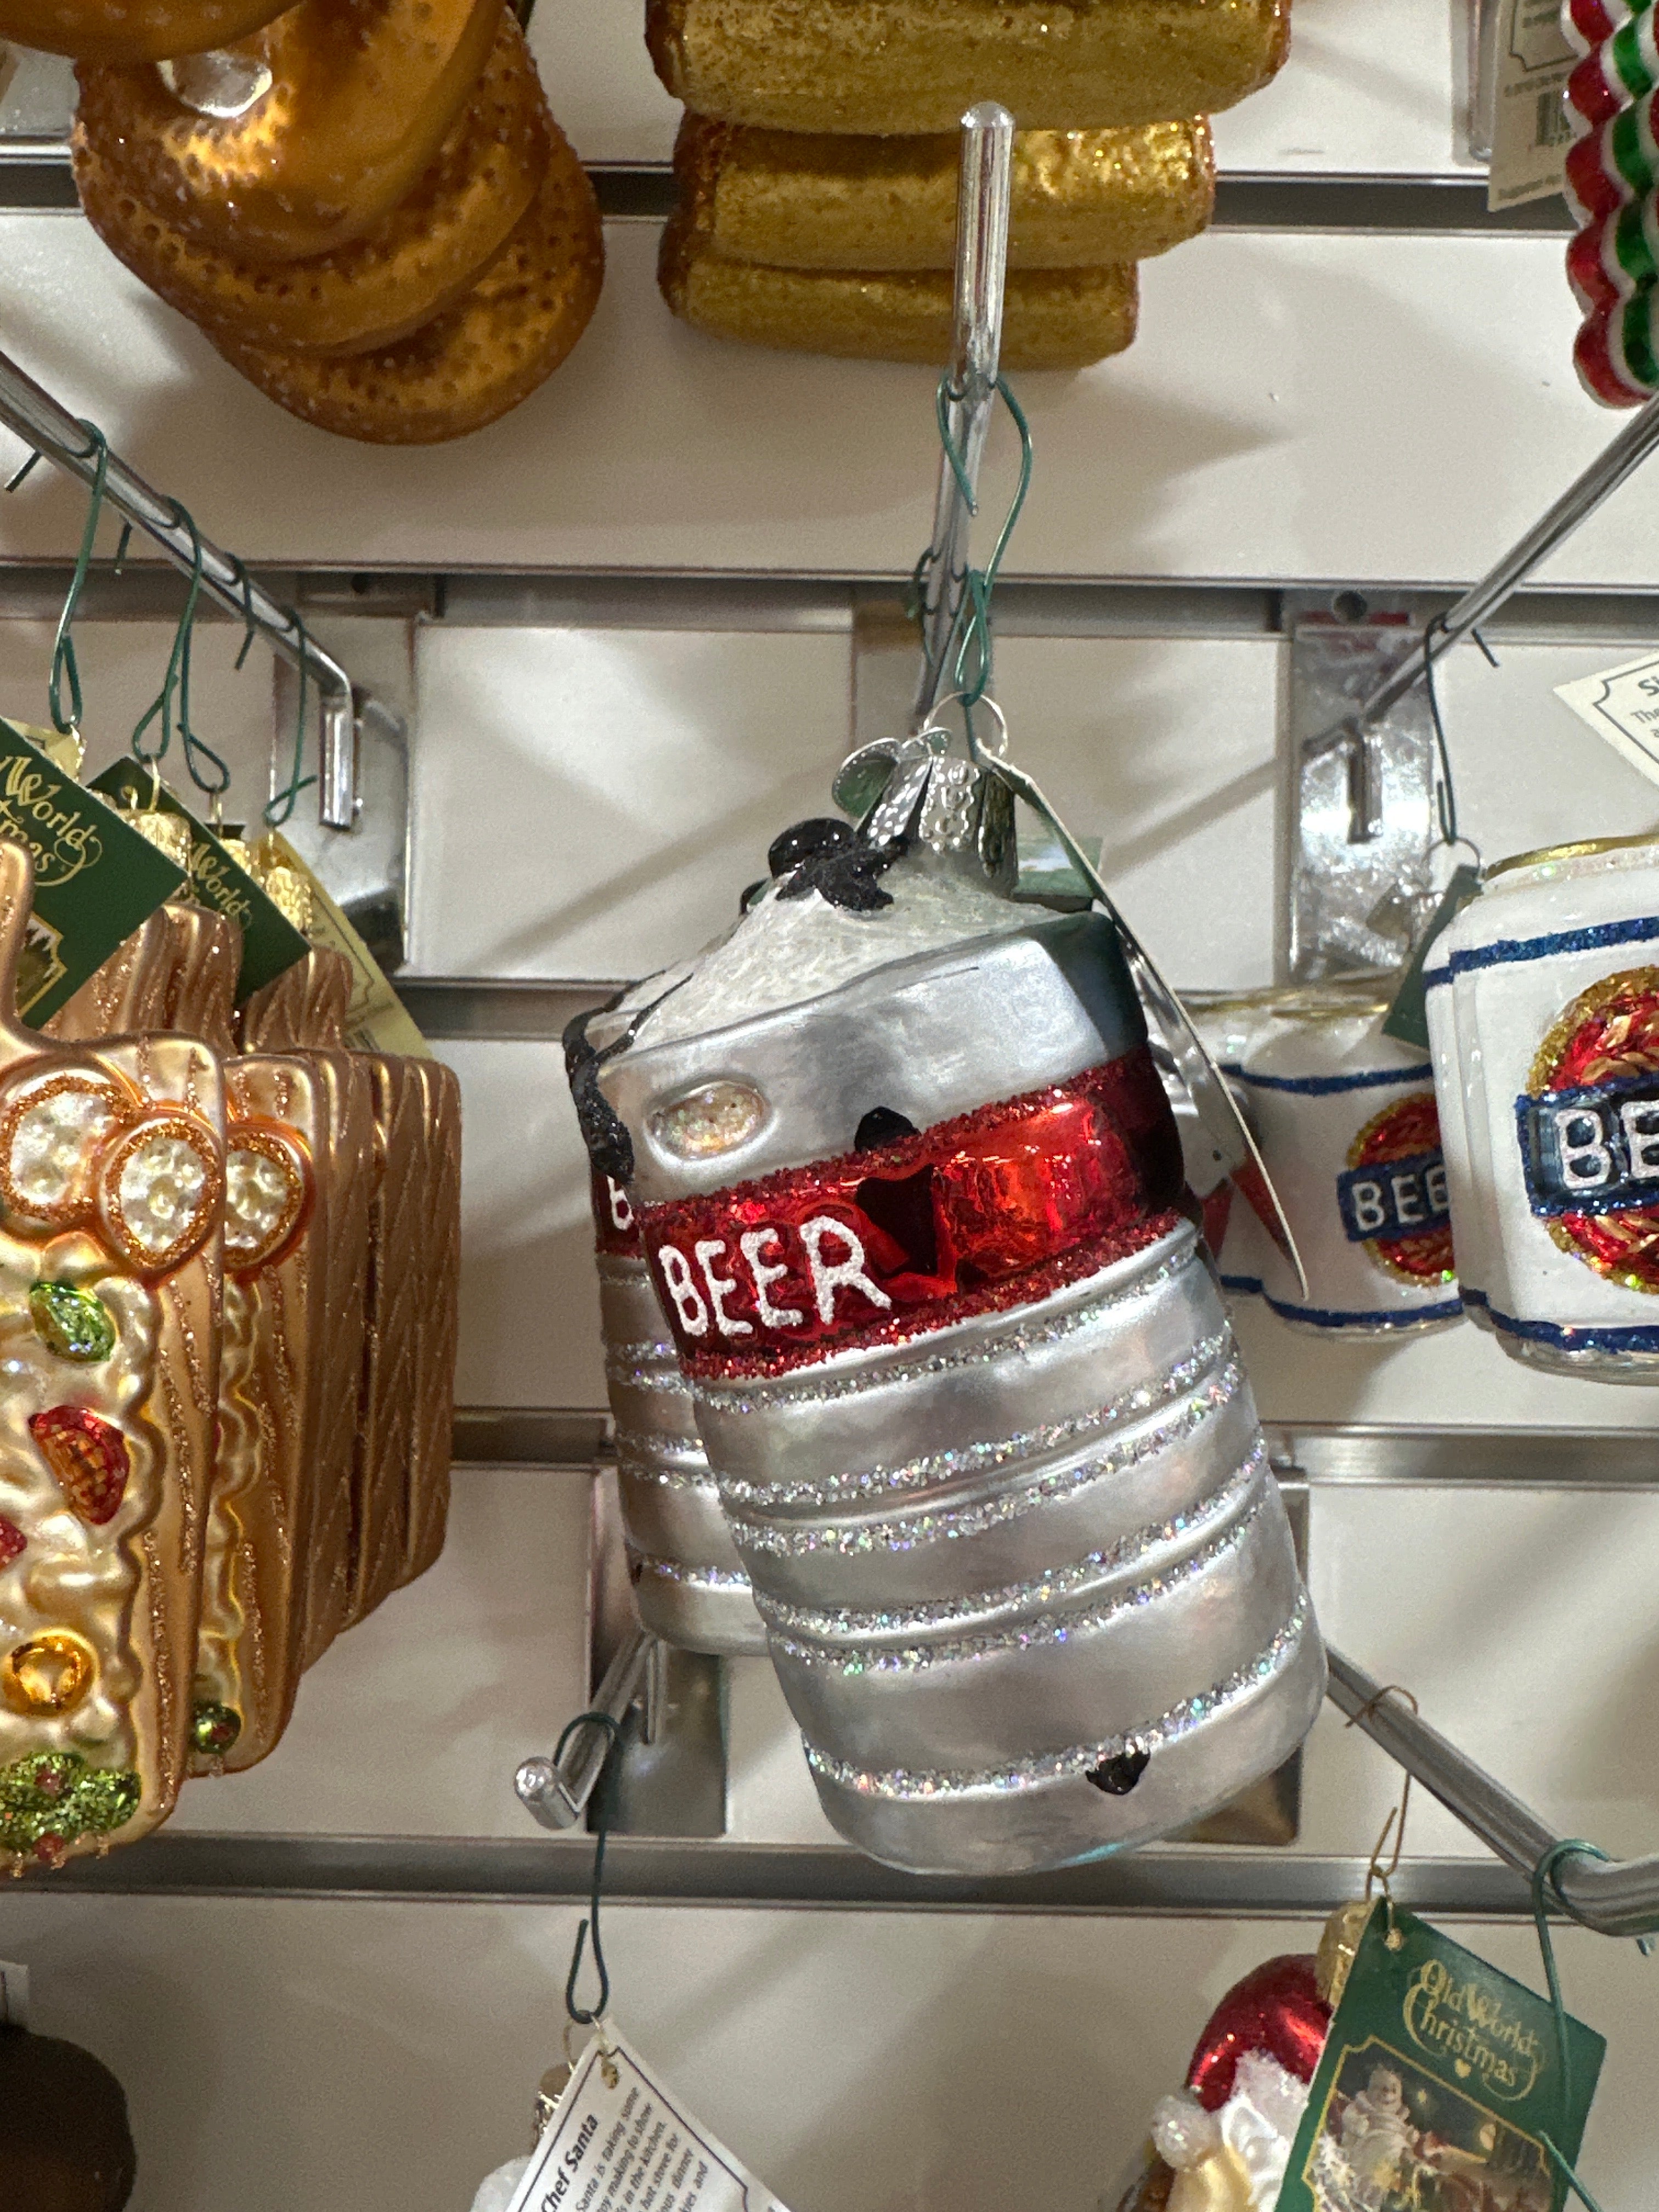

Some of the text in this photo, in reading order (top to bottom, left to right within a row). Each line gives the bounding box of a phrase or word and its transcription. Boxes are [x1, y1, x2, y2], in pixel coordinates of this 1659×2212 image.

[5, 755, 98, 852] World
[658, 1215, 891, 1337] BEER
[1403, 1983, 1517, 2087] Christmas
[1419, 1959, 1539, 2057] Old World
[541, 2114, 599, 2212] Chef Santa
[576, 2177, 600, 2212] Santa
[595, 2162, 606, 2179] is
[608, 2149, 635, 2197] making
[634, 2102, 653, 2136] show
[630, 2165, 645, 2190] the
[692, 2160, 709, 2190] and
